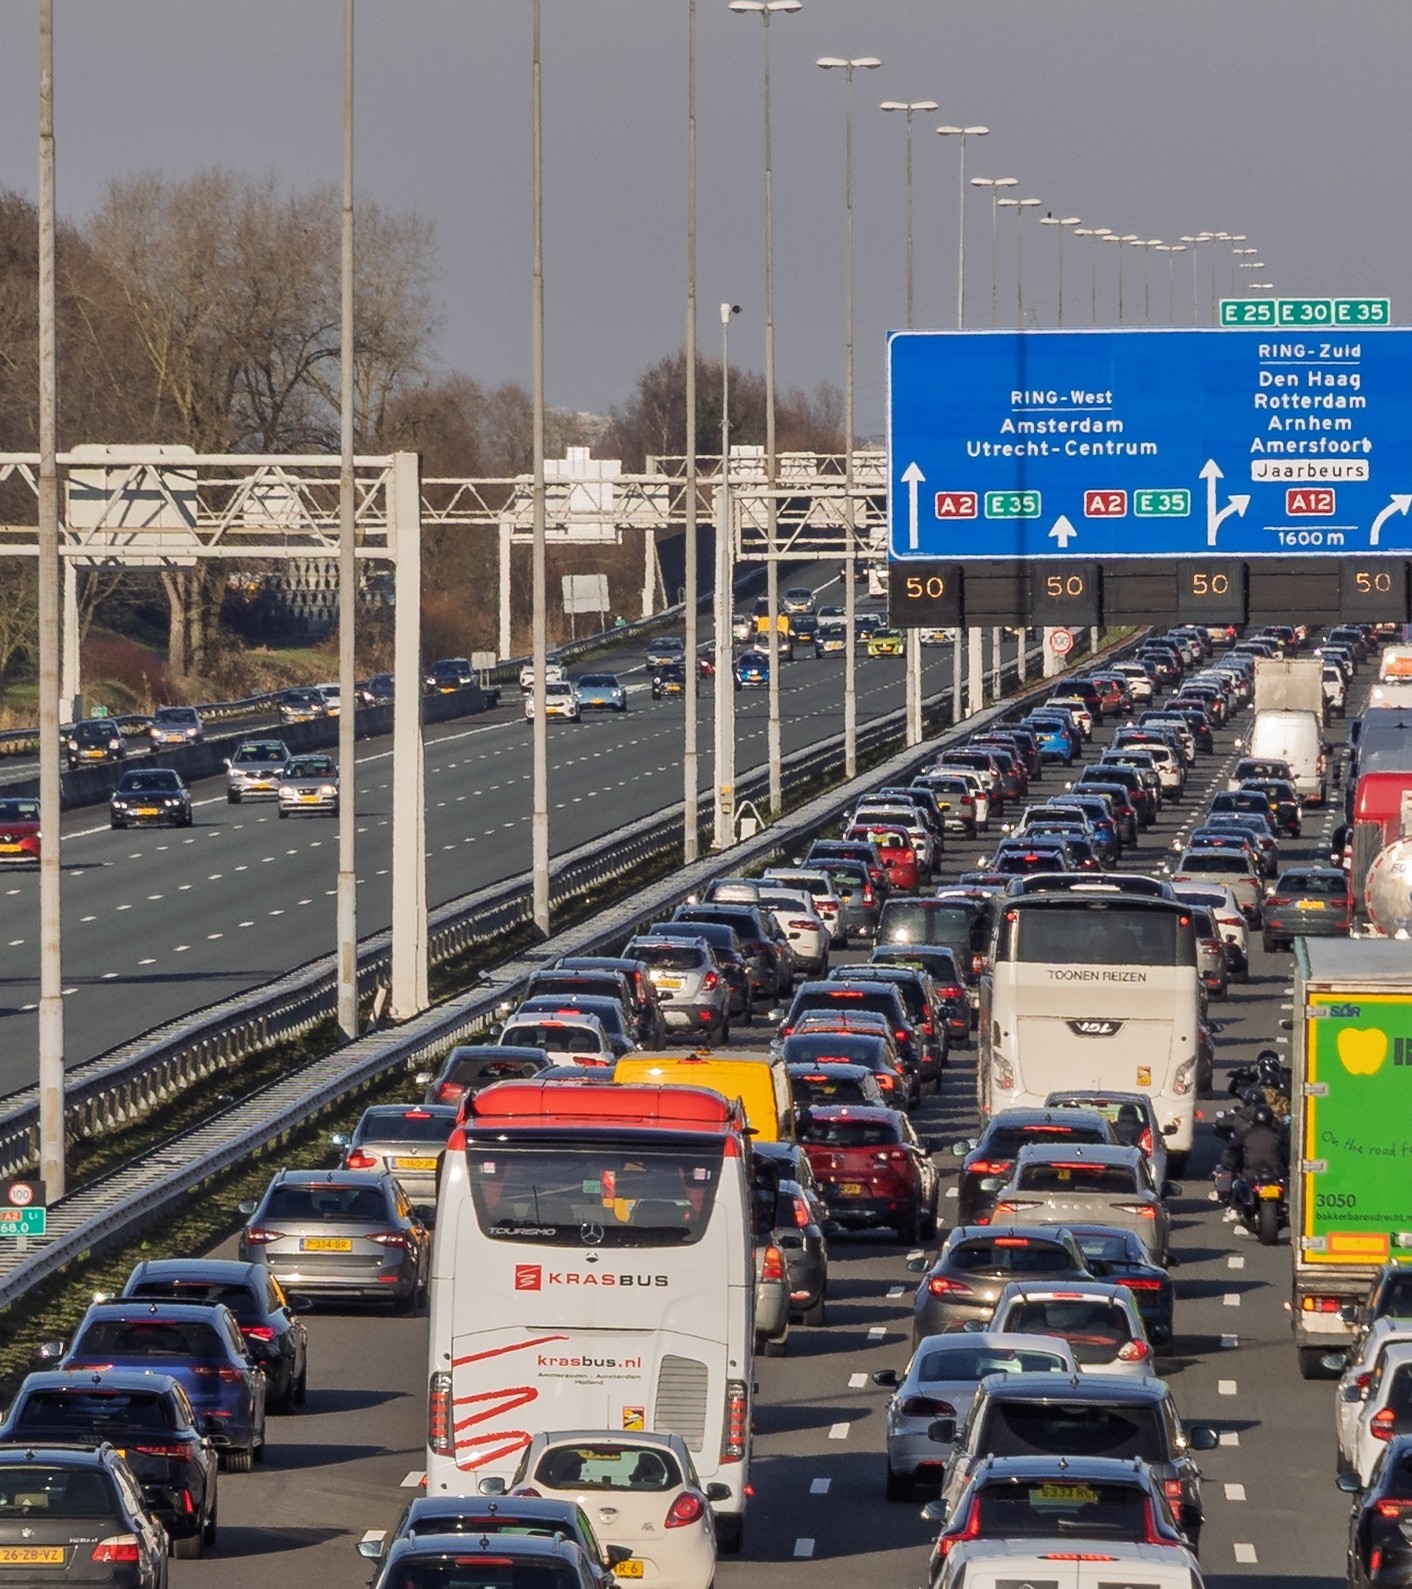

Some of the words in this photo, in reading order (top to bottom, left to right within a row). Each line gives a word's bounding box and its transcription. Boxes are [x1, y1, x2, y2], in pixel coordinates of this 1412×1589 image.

[1225, 304, 1238, 321] E
[1243, 304, 1271, 321] 25
[1282, 304, 1295, 321] E
[1300, 304, 1328, 321] 30
[1338, 304, 1351, 321] E
[1357, 304, 1384, 321] 35
[1259, 344, 1361, 358] RING-Zuid
[1260, 371, 1299, 387] Den
[1308, 371, 1361, 391] Haag
[1011, 390, 1113, 405] RING-West
[1254, 393, 1367, 409] Rotterdam
[1000, 417, 1124, 434] Amsterdam
[1267, 415, 1352, 431] Arnhem
[966, 440, 1158, 457] Utrecht-Centrum
[1250, 437, 1373, 454] Amersfoort
[1257, 463, 1365, 478] Jaarbeurs
[940, 497, 973, 514] A2
[992, 497, 1004, 513] E
[1009, 496, 1036, 513] 35
[1089, 495, 1122, 512] A2
[1141, 495, 1153, 512] E
[1158, 495, 1186, 512] 35
[1291, 494, 1331, 510] A12
[1278, 532, 1323, 546] 1600
[1327, 533, 1345, 545] m
[906, 576, 945, 599] 50
[1047, 576, 1084, 597] 50
[1192, 573, 1229, 595] 50
[1355, 572, 1392, 593] 50
[1047, 969, 1100, 981] TOONEN
[1102, 971, 1147, 982] REIZEN
[1321, 1131, 1339, 1146] On
[1344, 1138, 1364, 1154] the
[1369, 1142, 1396, 1157] road
[13, 1190, 29, 1200] 100
[1315, 1193, 1357, 1208] 3050
[1, 1222, 30, 1233] 68.0
[488, 1227, 557, 1236] TOURISMO
[549, 1272, 669, 1287] KRASBUS
[537, 1354, 642, 1368] krasbus.nl
[3, 1549, 59, 1561] 26-ZB-VZ
